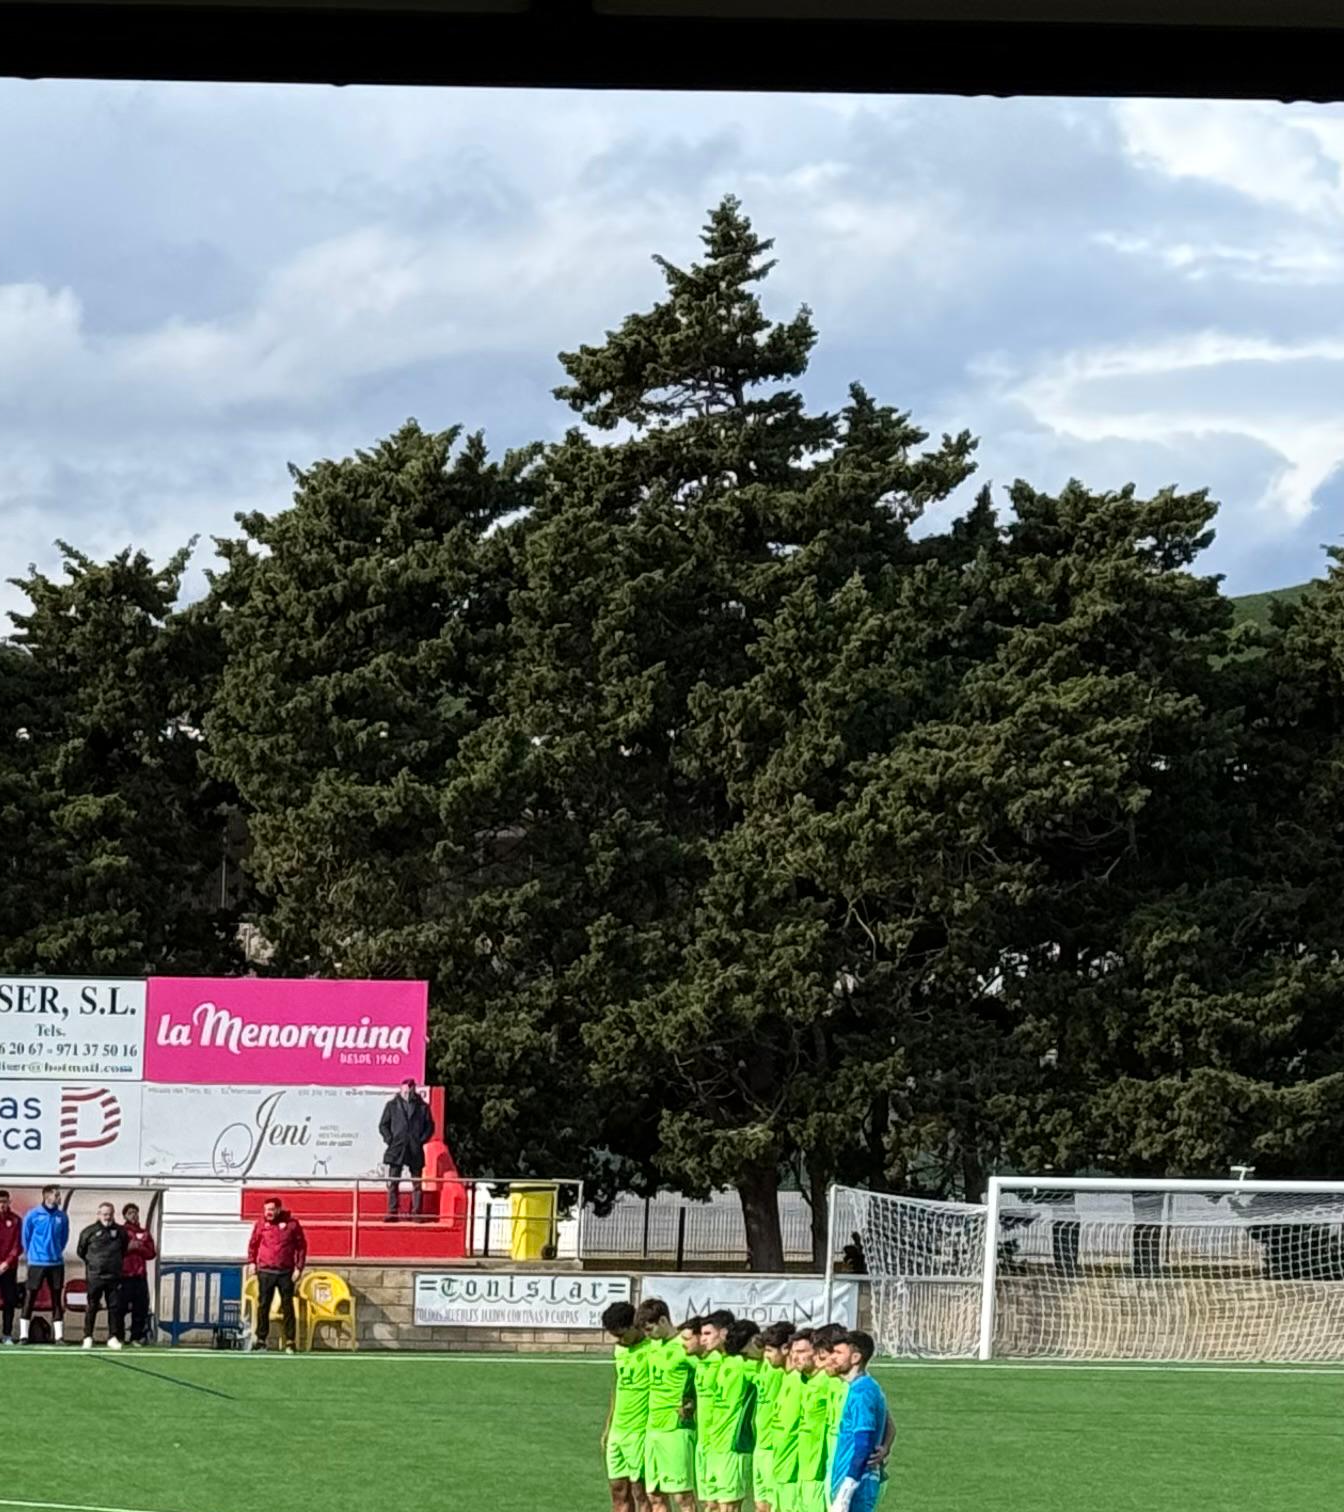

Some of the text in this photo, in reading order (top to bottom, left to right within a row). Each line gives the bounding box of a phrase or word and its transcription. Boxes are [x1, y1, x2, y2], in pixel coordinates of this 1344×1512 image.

[79, 986, 136, 1015] S.L.
[35, 1024, 66, 1038] Tels.
[157, 1002, 412, 1059] la Menorquina
[9, 1043, 24, 1055] 20
[56, 1043, 78, 1056] 971
[83, 1044, 98, 1056] 37
[102, 1044, 118, 1057] 50
[122, 1044, 138, 1057] 16
[340, 1053, 400, 1065] DESDE 1940
